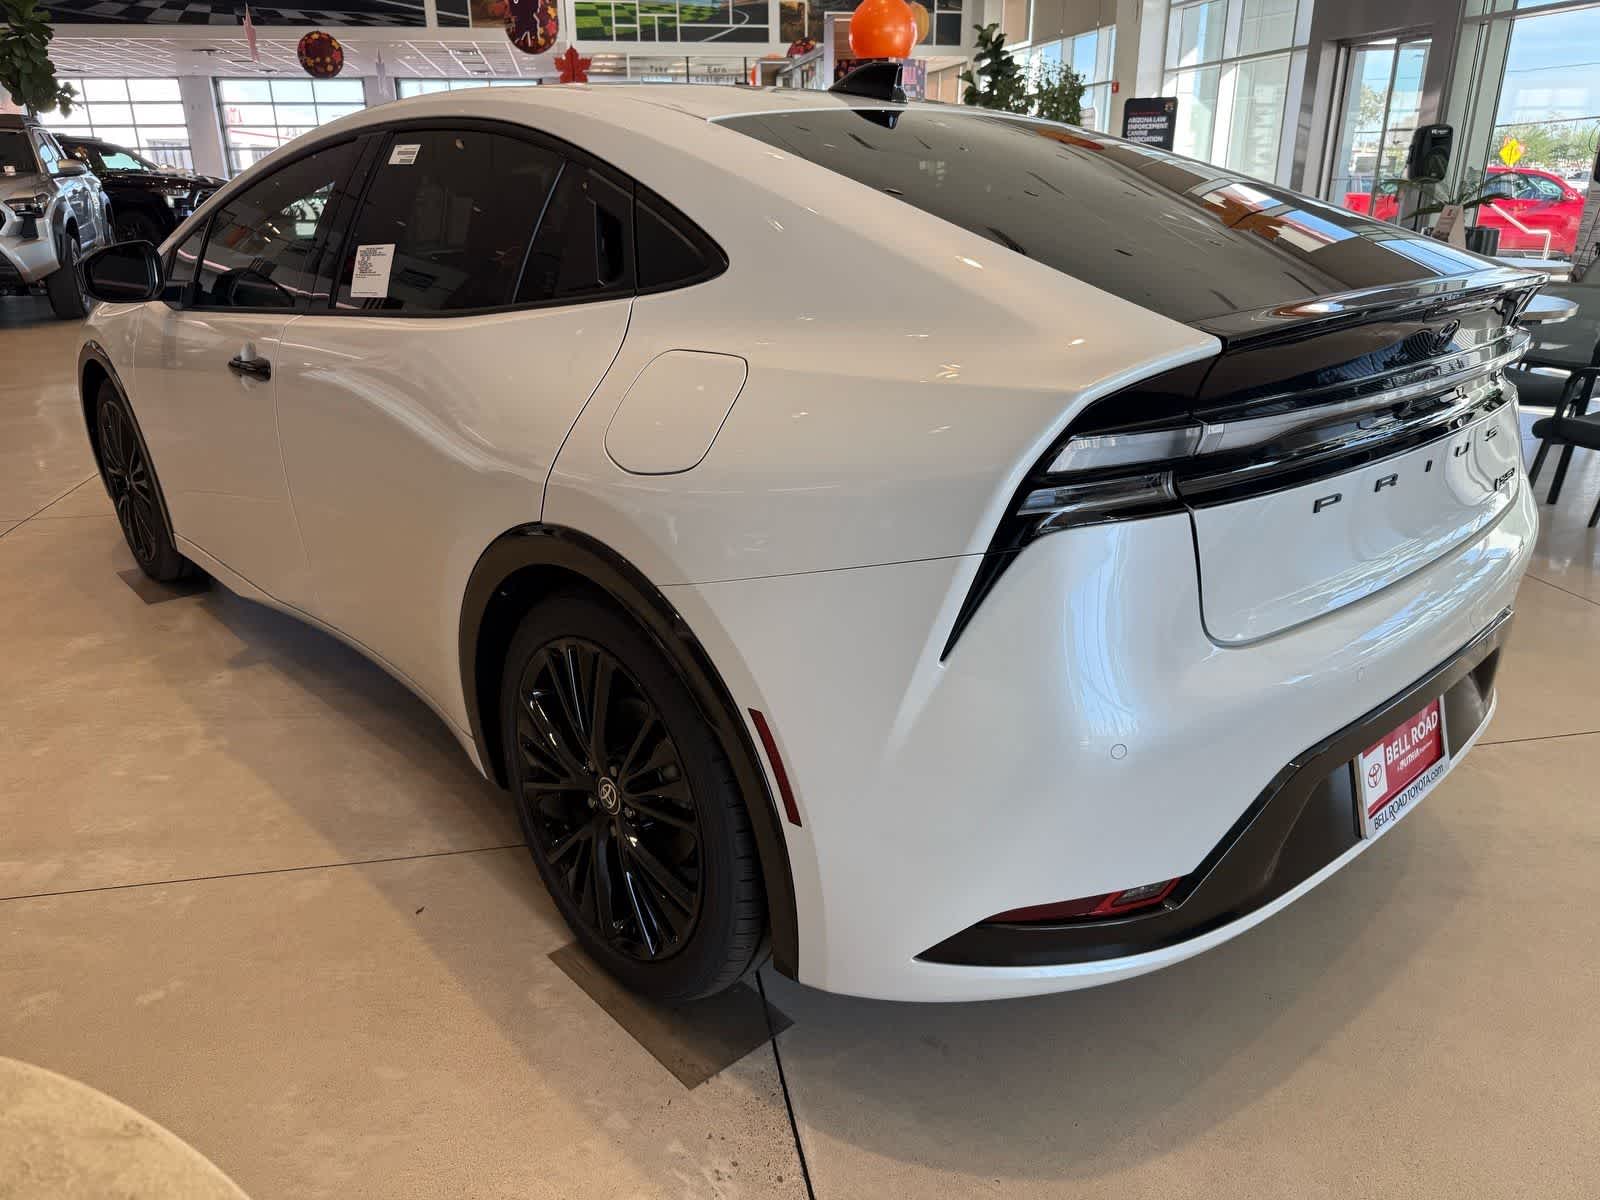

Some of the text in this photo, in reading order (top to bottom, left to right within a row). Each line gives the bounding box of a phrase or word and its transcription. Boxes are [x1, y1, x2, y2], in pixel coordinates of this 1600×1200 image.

[1312, 425, 1498, 514] PRIUS
[1386, 733, 1411, 765] BELL
[1411, 710, 1438, 746] ROAD
